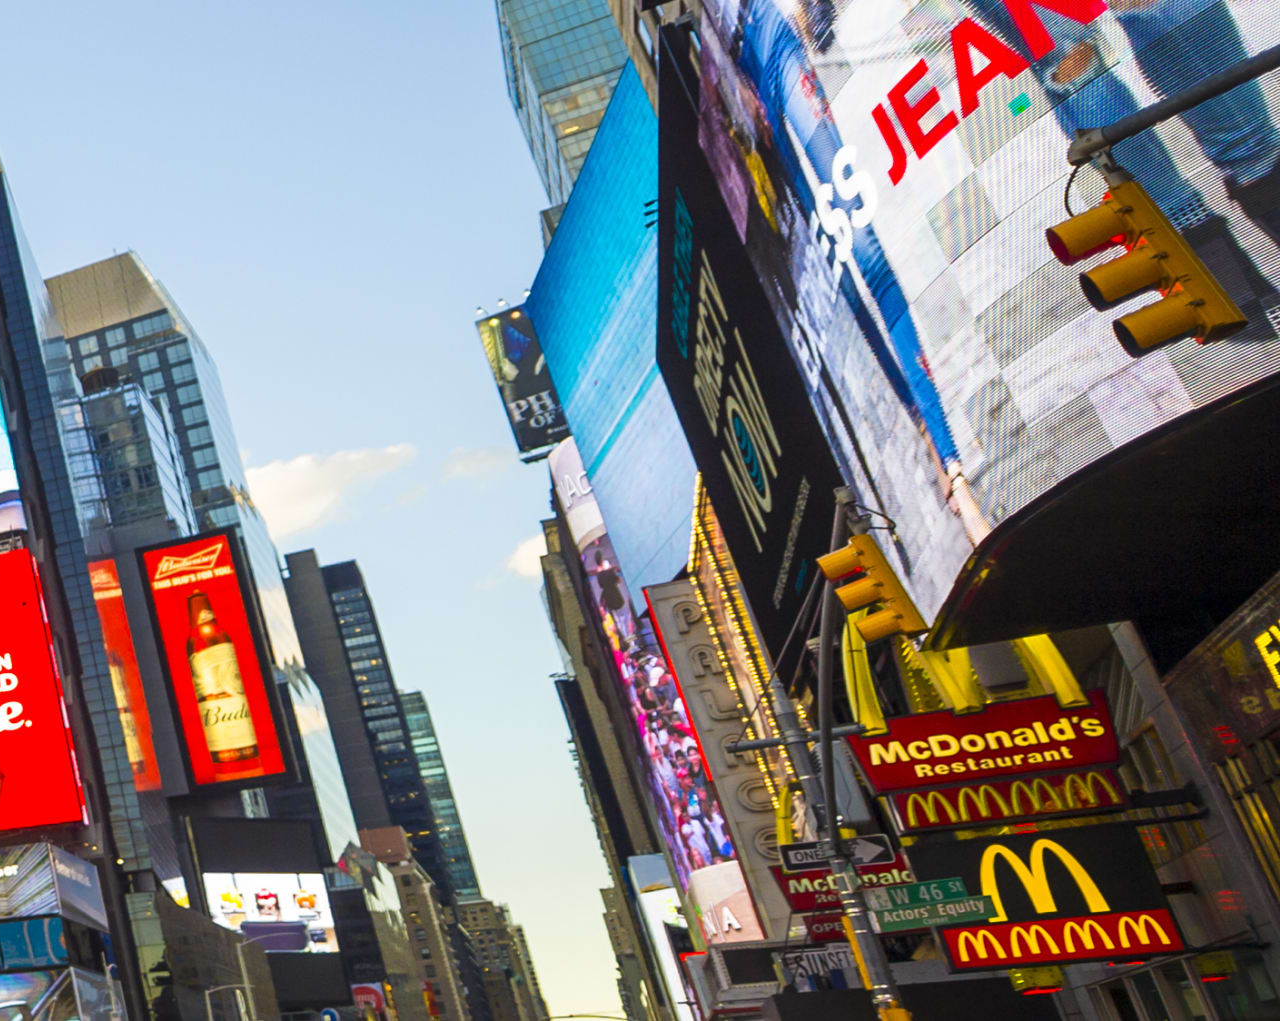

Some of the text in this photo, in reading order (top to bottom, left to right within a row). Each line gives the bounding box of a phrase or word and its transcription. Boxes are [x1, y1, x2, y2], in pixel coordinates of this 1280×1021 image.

[868, 716, 1106, 767] McDonald's
[914, 745, 1074, 779] Restaurant
[794, 848, 824, 863] ONE
[891, 880, 964, 905] W 46 St
[883, 899, 985, 923] Actors' Equity
